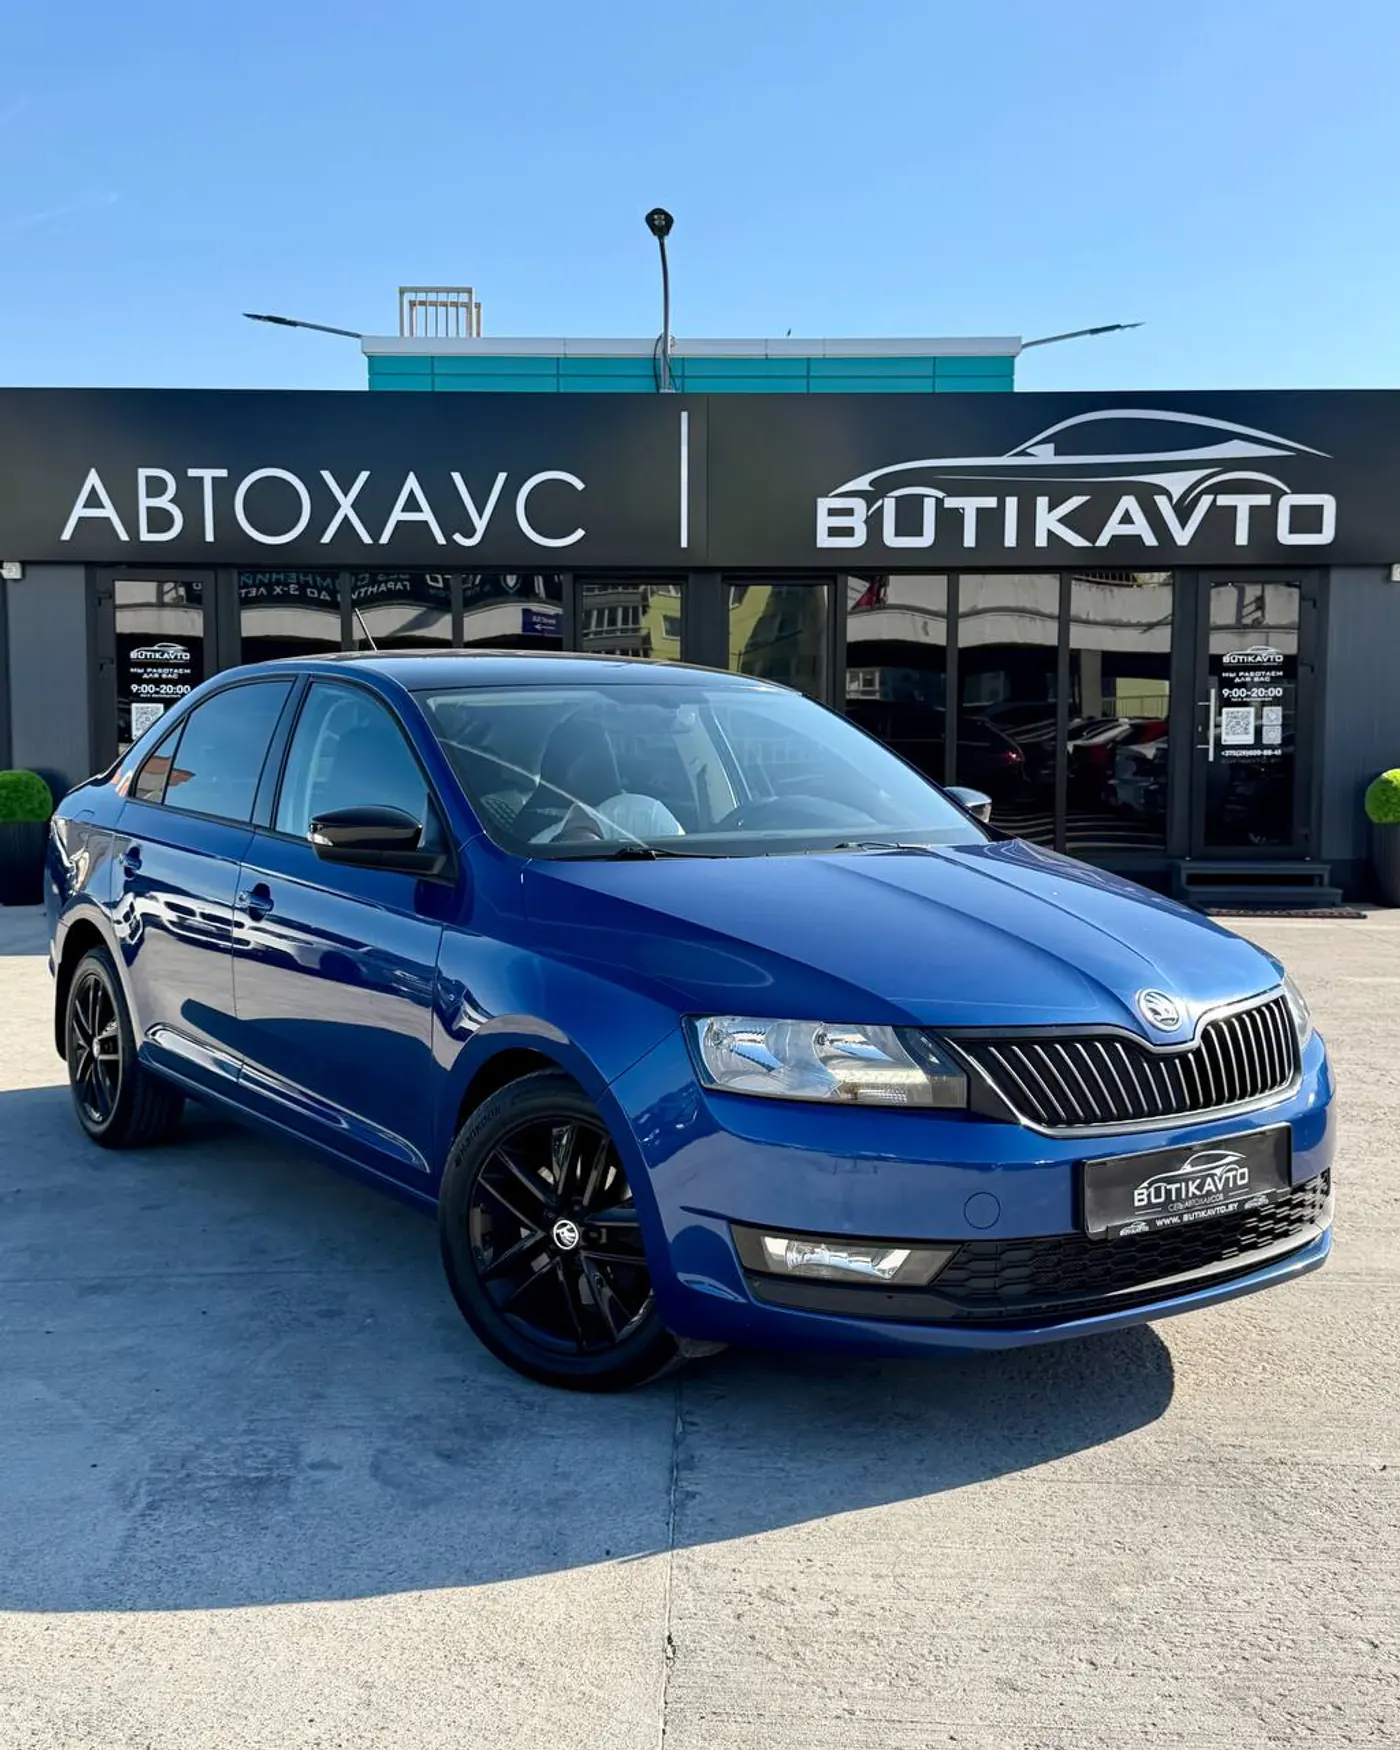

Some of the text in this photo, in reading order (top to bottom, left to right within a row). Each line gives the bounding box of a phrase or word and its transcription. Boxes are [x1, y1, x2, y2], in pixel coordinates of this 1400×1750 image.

[60, 467, 587, 548] АВТОХАУС
[816, 493, 1336, 549] BUTIKAVTO
[130, 651, 190, 659] BUTIKAVTO
[1222, 655, 1283, 663] BUTIKAVTO
[131, 684, 191, 693] 9:00-20:00
[1222, 688, 1283, 698] 9:00-20:00
[1134, 1167, 1249, 1207] BUTIKAVTO
